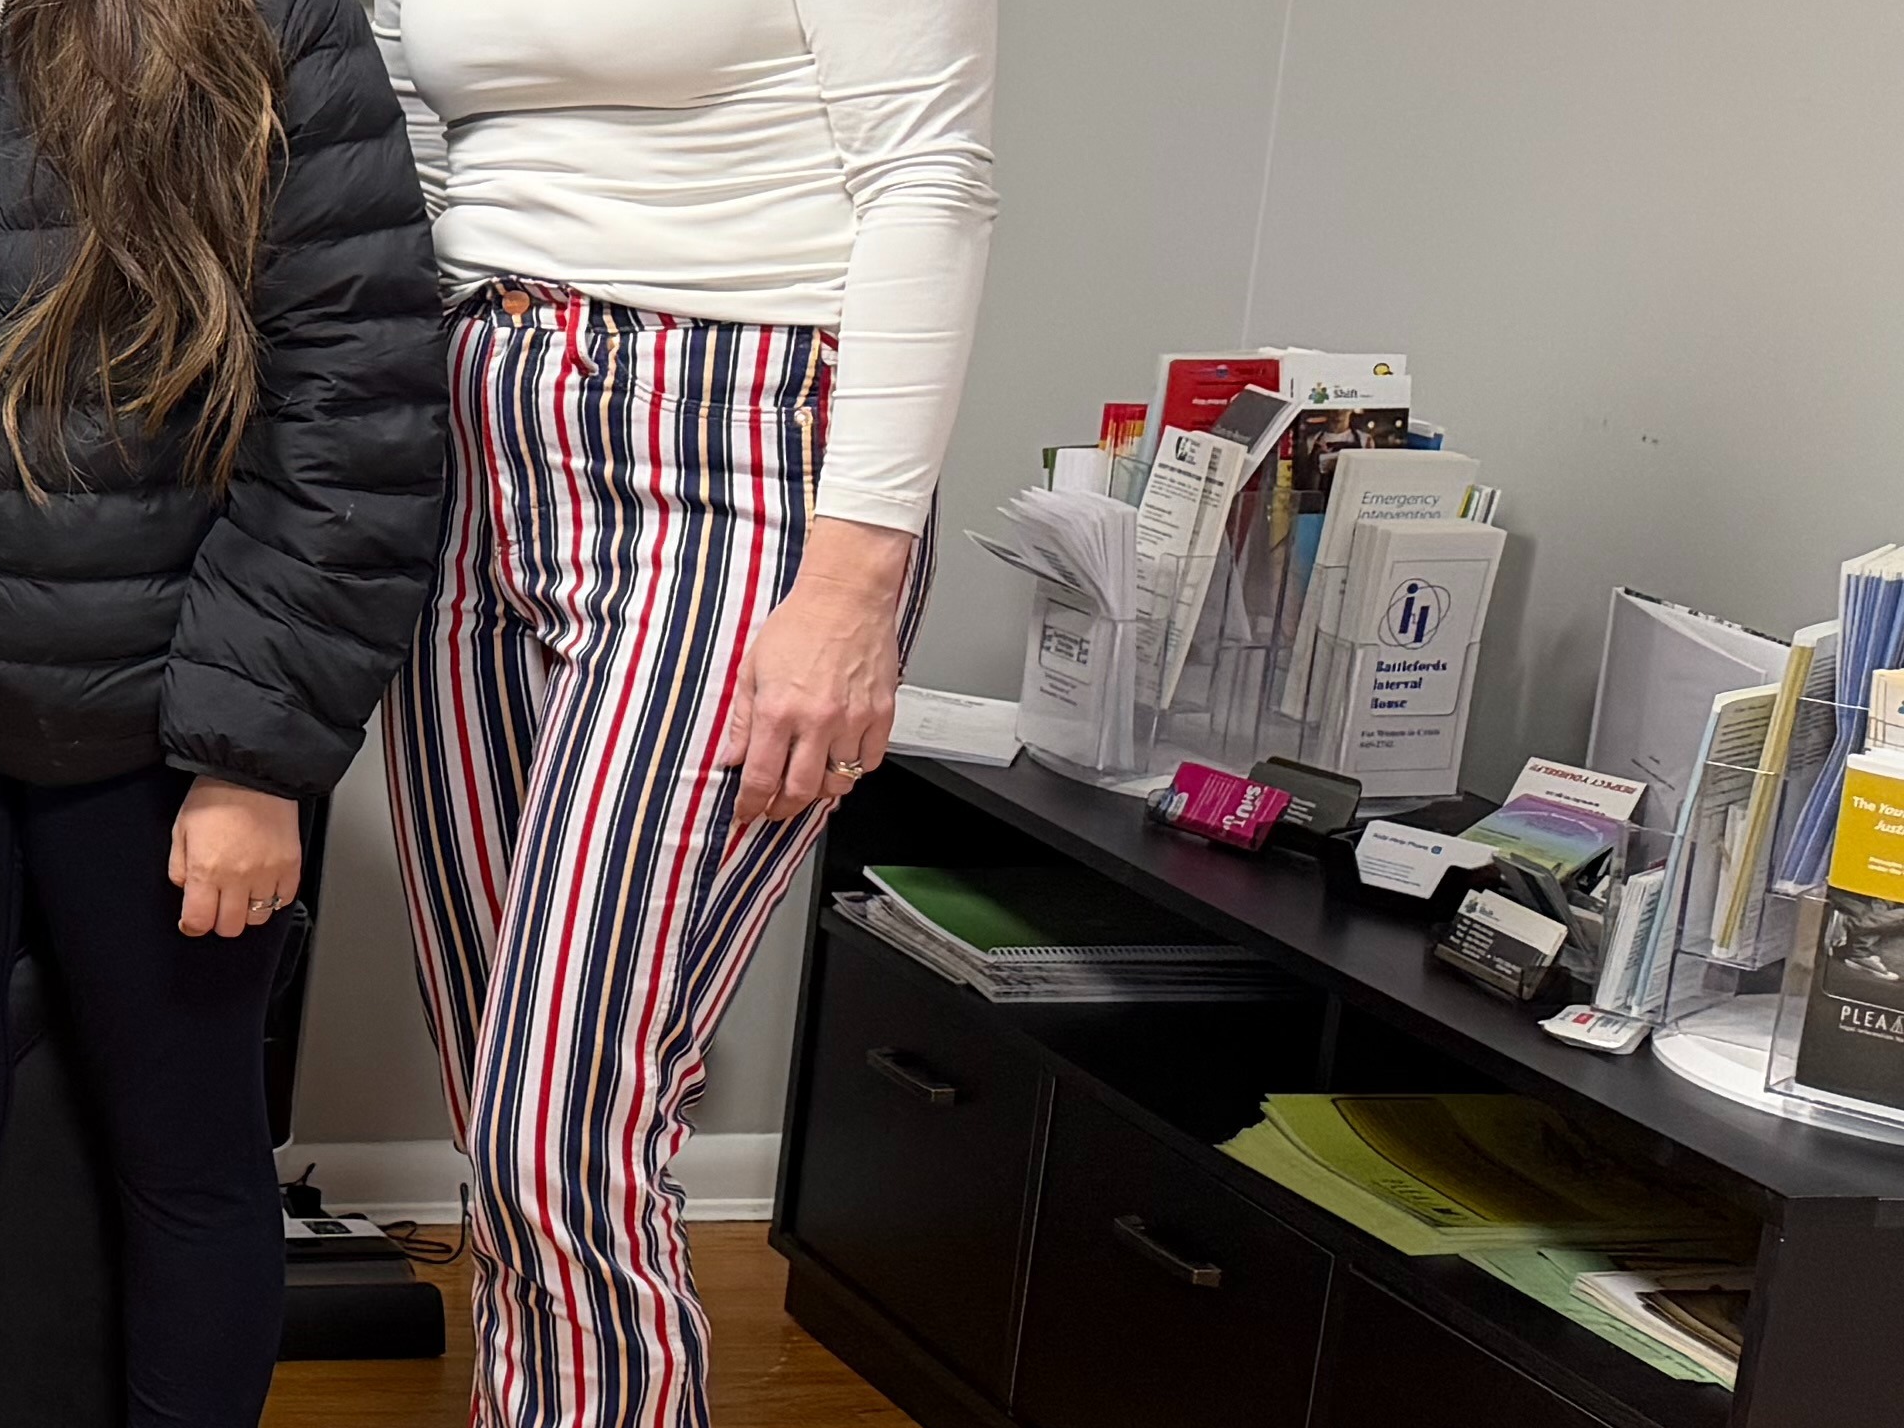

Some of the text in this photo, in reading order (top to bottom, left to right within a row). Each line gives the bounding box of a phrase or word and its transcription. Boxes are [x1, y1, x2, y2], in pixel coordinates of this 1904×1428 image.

[1361, 492, 1441, 506] Emergency
[1359, 510, 1441, 520] Intervention
[1376, 661, 1447, 672] Battlefords
[1373, 677, 1423, 690] Interval
[1371, 698, 1408, 709] House
[1589, 776, 1638, 796] RESPECT
[1234, 785, 1262, 829] SHUT
[1853, 796, 1876, 811] The
